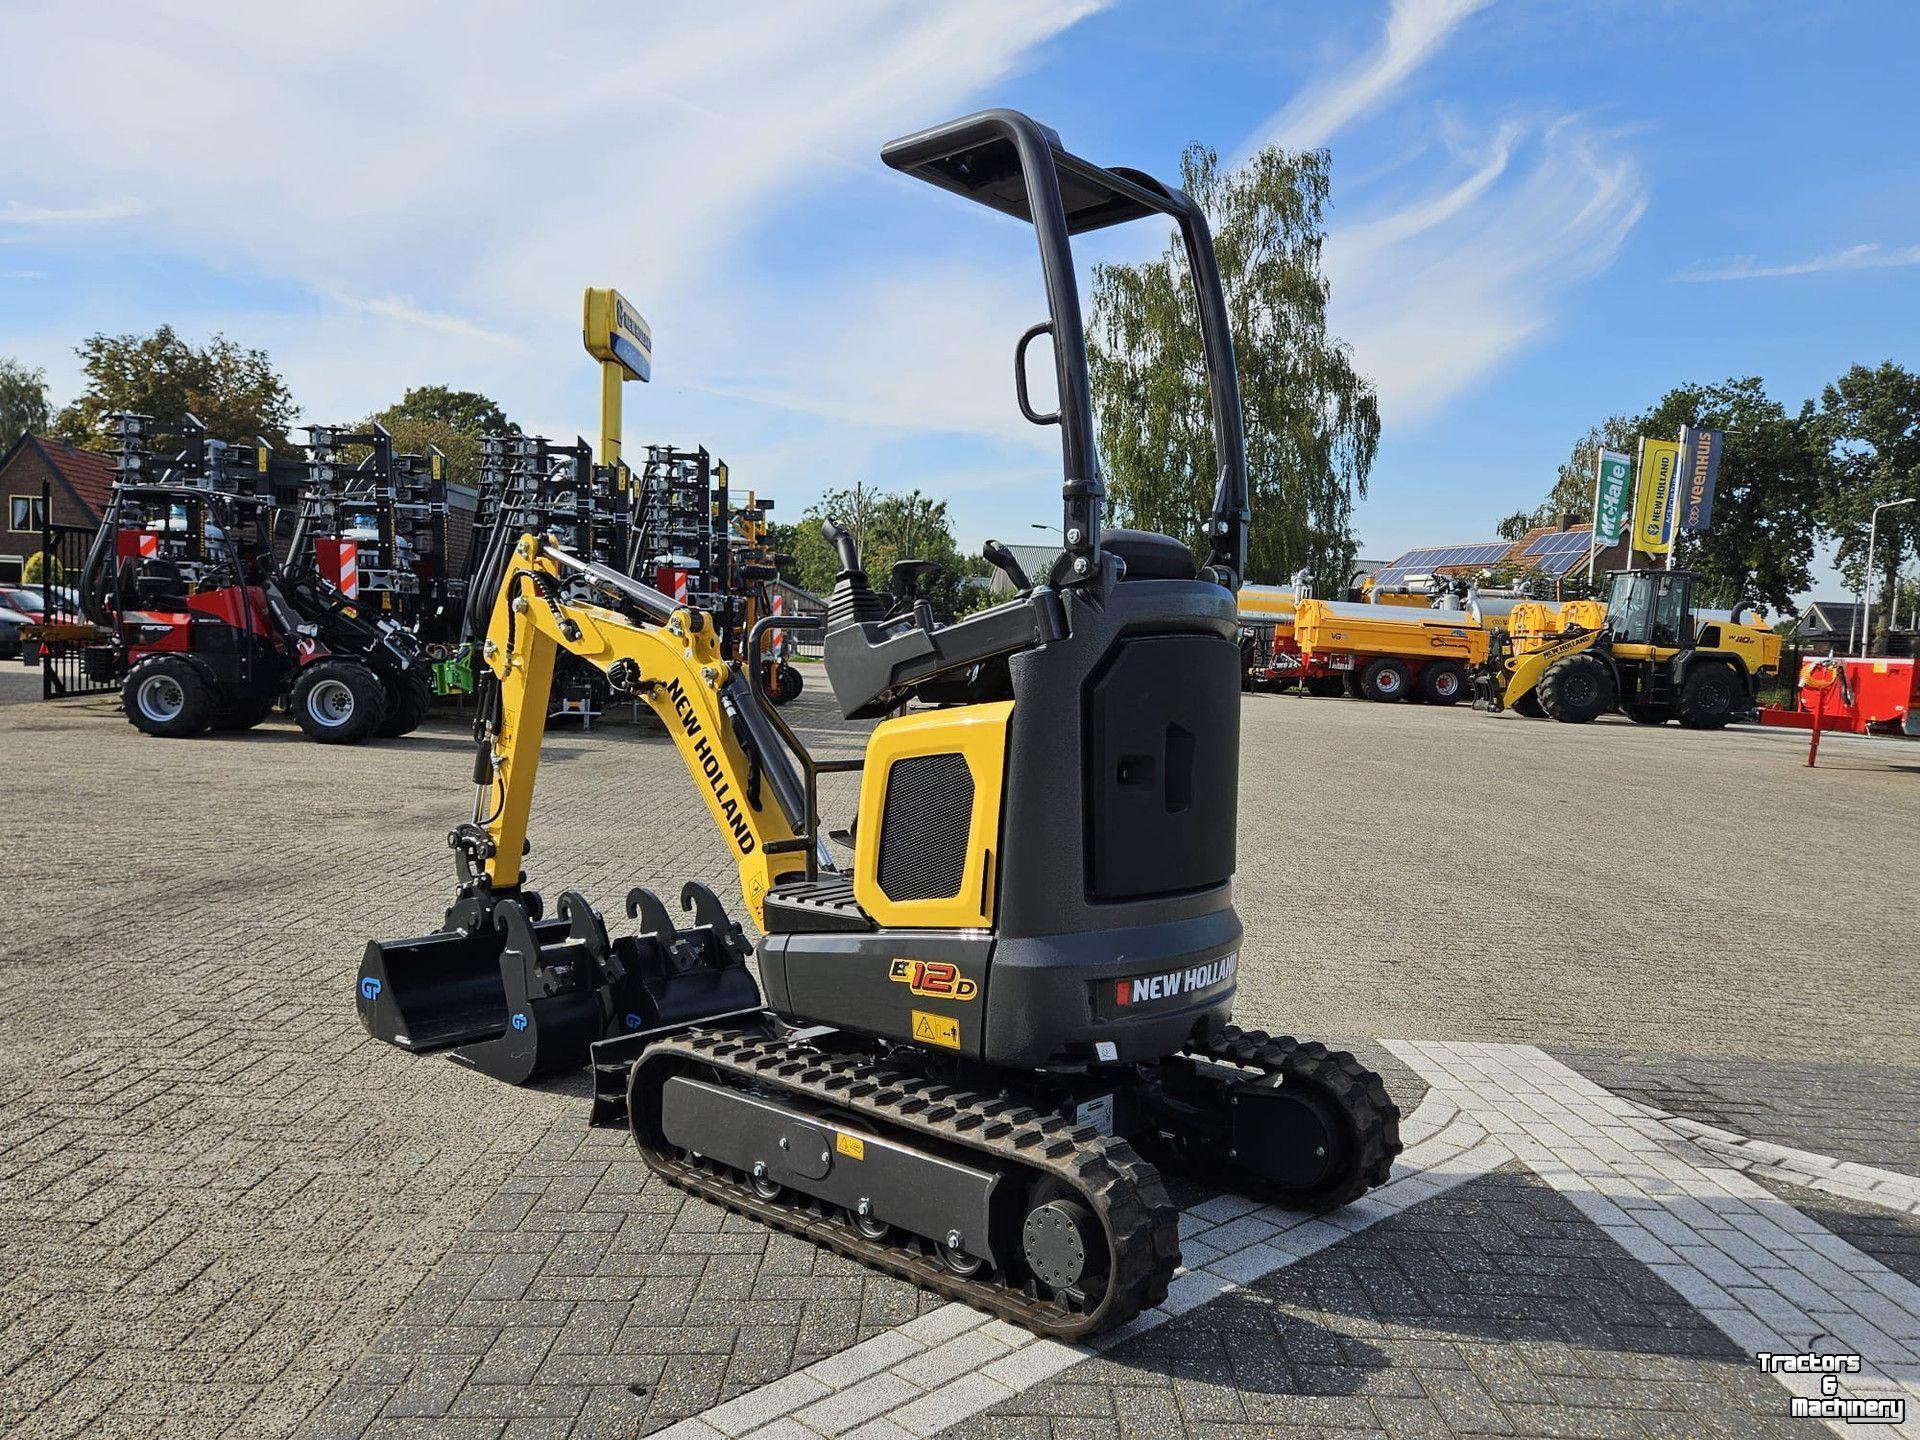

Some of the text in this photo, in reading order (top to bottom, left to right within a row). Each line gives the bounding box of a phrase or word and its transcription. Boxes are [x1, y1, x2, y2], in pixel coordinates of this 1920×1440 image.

[1601, 464, 1626, 536] McHale
[1652, 457, 1670, 522] NEW HOLLAND
[1543, 635, 1590, 659] NEW HOLLAND
[666, 676, 756, 855] NEW HOLLAND
[1132, 972, 1182, 1003] NEW
